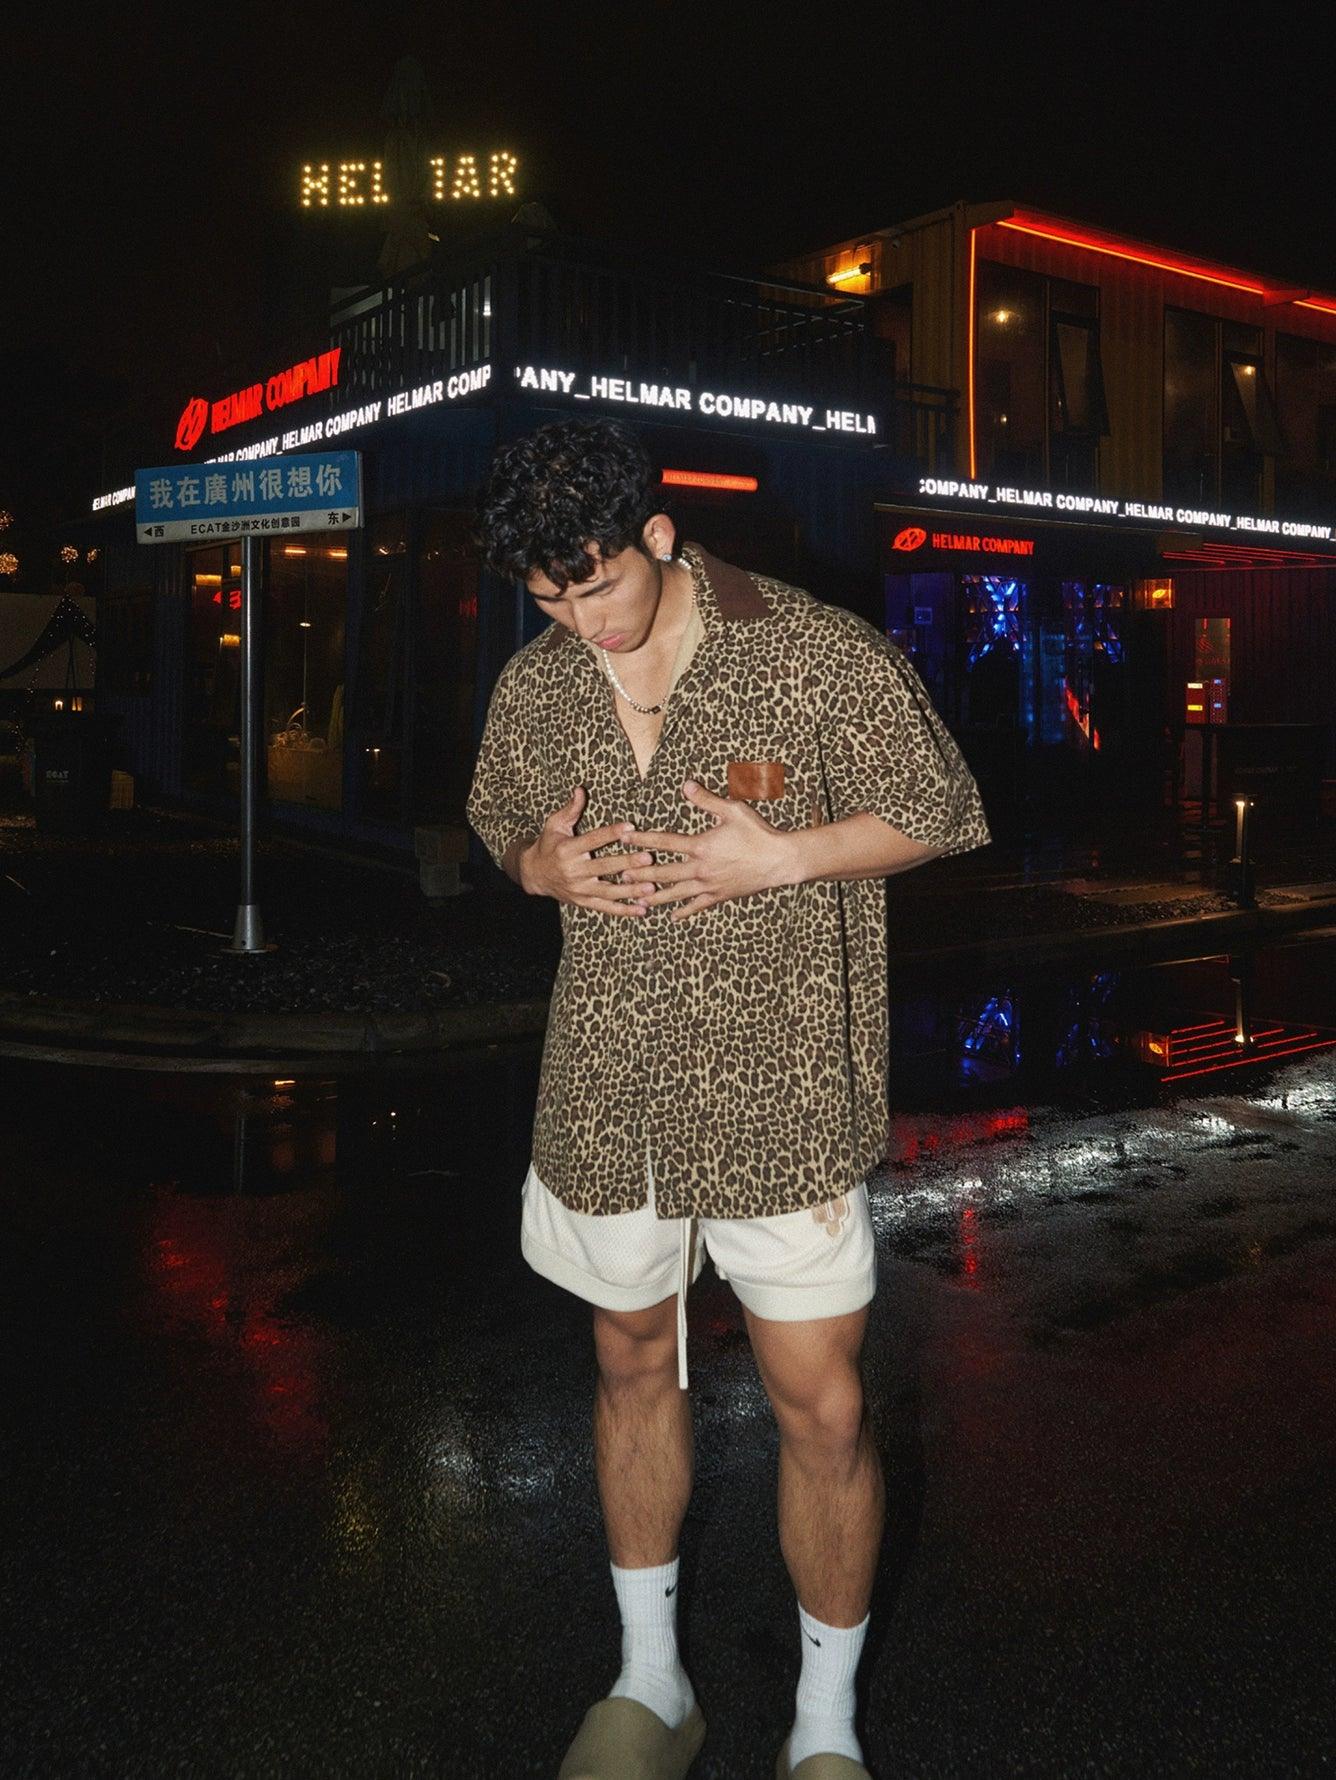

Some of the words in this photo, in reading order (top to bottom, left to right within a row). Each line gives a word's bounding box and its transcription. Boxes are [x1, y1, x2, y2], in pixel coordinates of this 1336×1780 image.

[211, 384, 264, 434] HELMAR
[265, 348, 342, 411] COMPANY
[325, 401, 382, 438] COMPANY
[387, 380, 444, 417] HELMAR
[149, 463, 344, 509] 我在廣州很想你
[154, 525, 165, 538] 西
[327, 512, 340, 526] 东
[932, 533, 981, 551] HELMAR
[981, 537, 1034, 555] COMPANY
